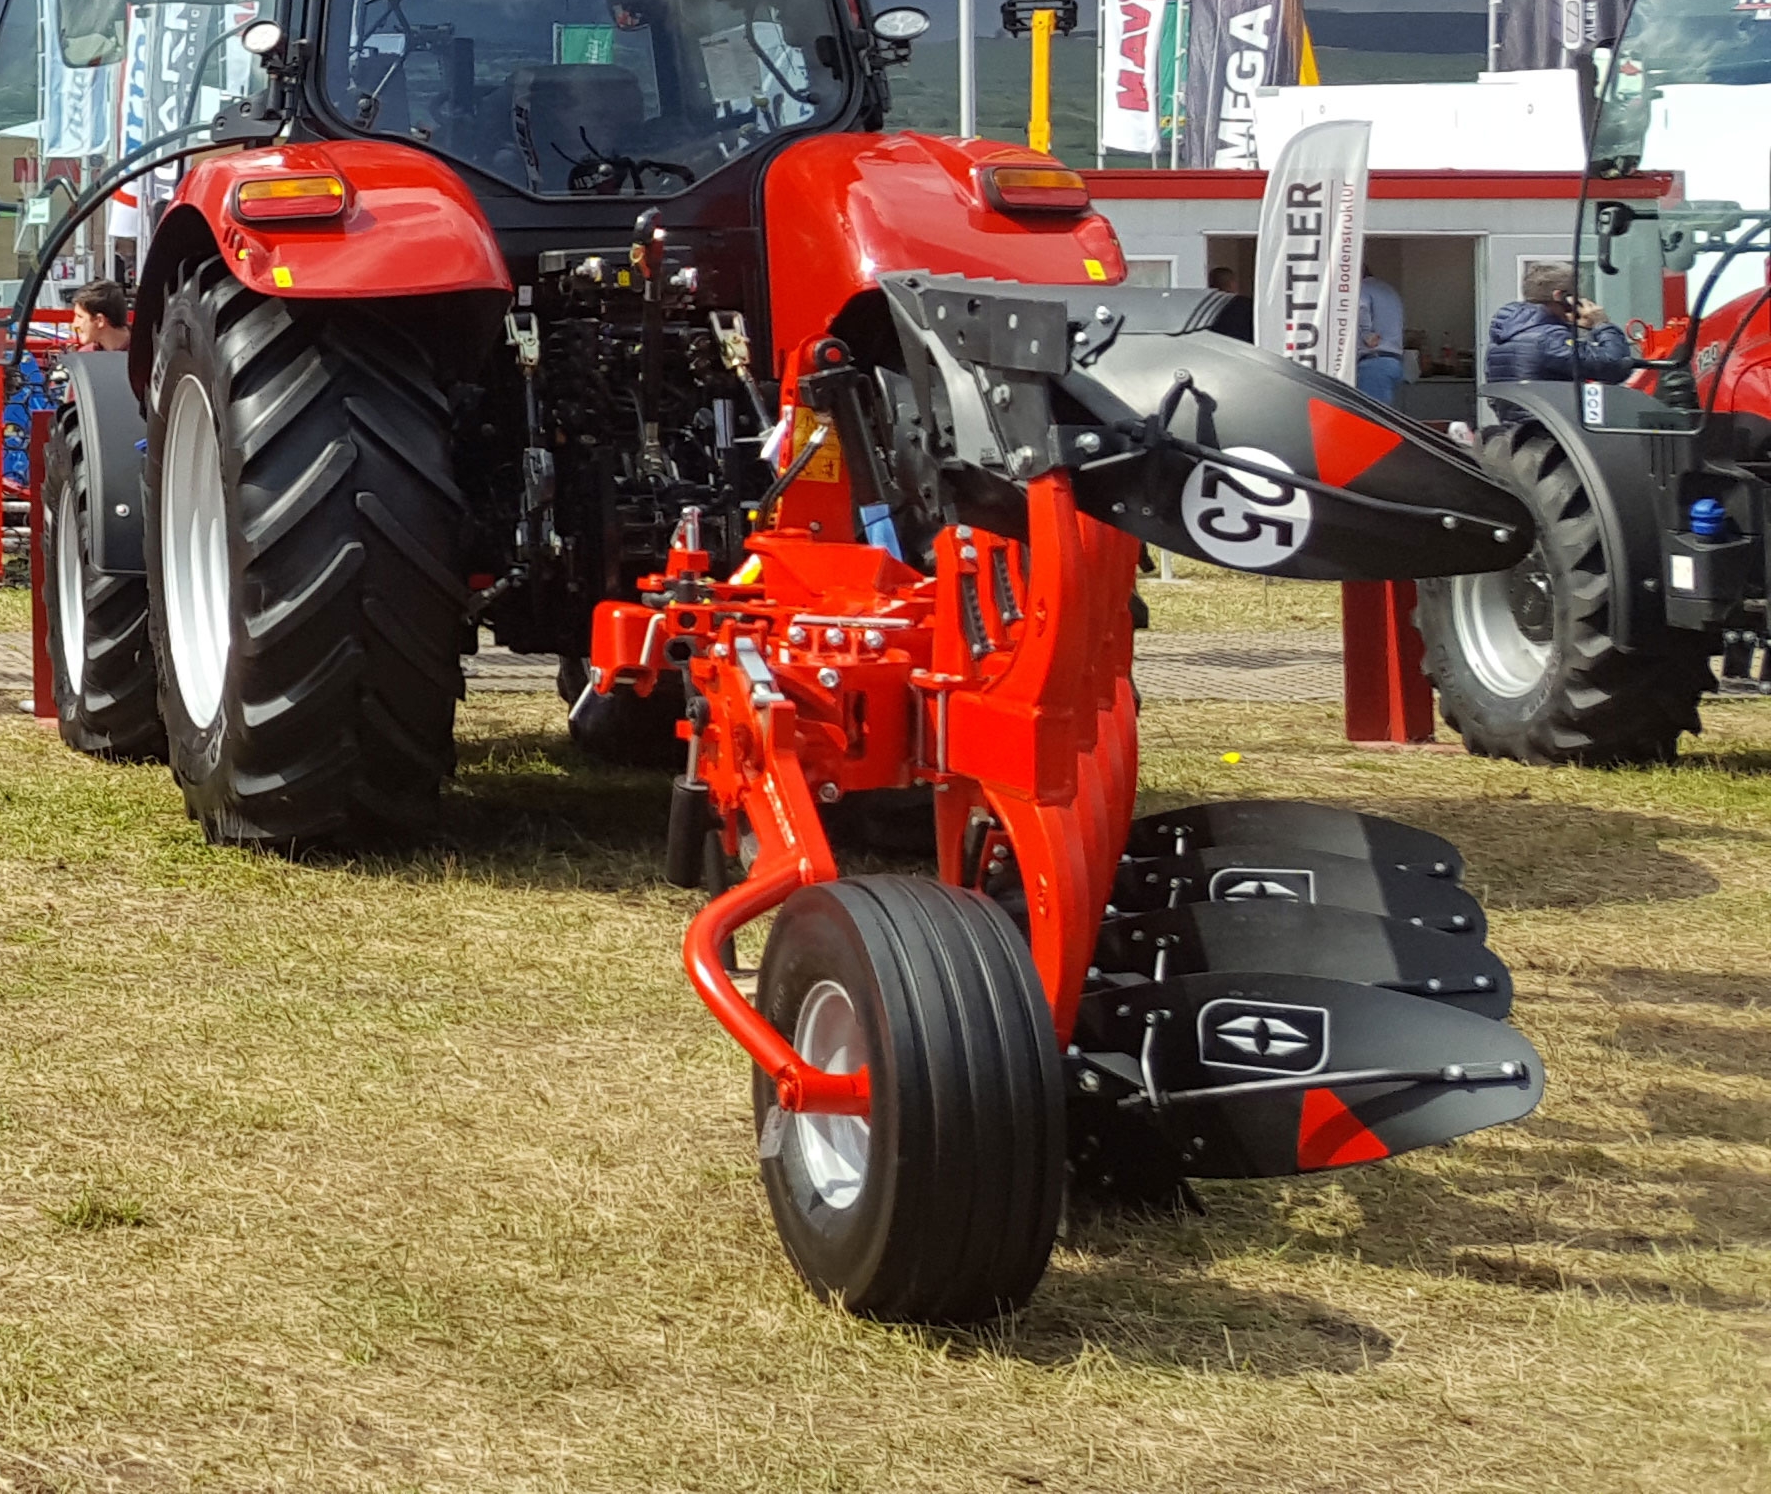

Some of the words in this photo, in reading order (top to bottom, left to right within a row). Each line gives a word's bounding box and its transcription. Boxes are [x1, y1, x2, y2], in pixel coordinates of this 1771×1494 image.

[1338, 180, 1355, 293] Bodenstruktur
[1338, 298, 1350, 313] in
[1197, 464, 1297, 548] 25
